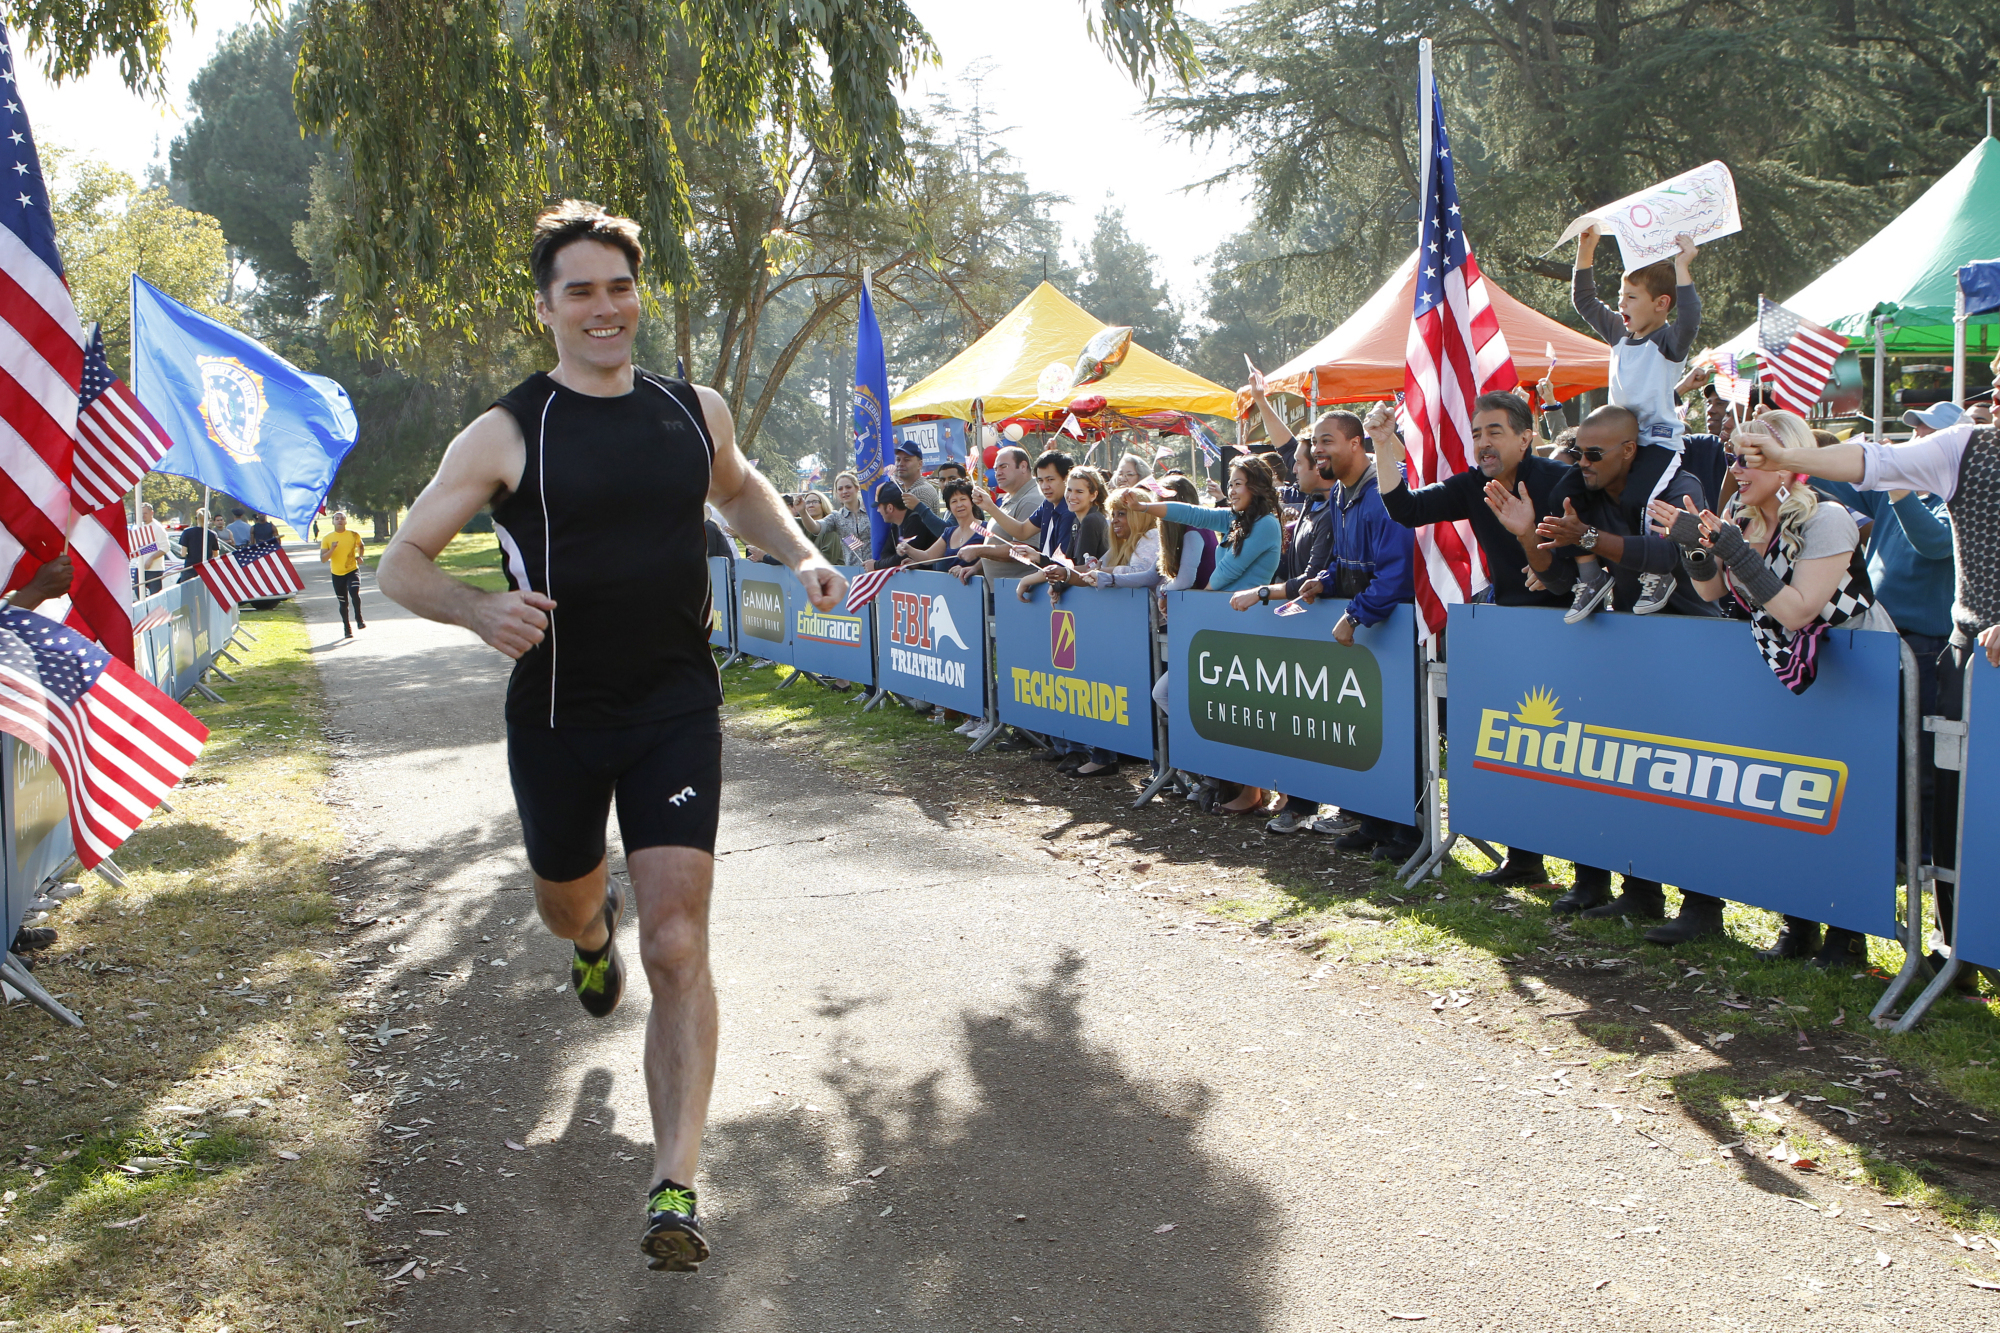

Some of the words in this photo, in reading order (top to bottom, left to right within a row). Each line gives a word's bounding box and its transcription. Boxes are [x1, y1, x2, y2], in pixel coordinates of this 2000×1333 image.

[662, 420, 685, 431] TYR
[743, 589, 782, 614] GAMMA
[745, 615, 762, 628] ENERGY
[764, 619, 780, 632] DRINK
[890, 590, 932, 651] FBI
[797, 610, 860, 642] Endurance
[890, 647, 966, 689] TRIATHLON
[1199, 650, 1367, 708] GAMMA
[1011, 666, 1129, 727] TECHSTRIDE
[1207, 700, 1278, 732] ENERGY
[1292, 714, 1358, 747] DRINK
[17, 743, 49, 790] GAM
[1474, 707, 1833, 821] Endurance
[668, 785, 697, 807] TYR
